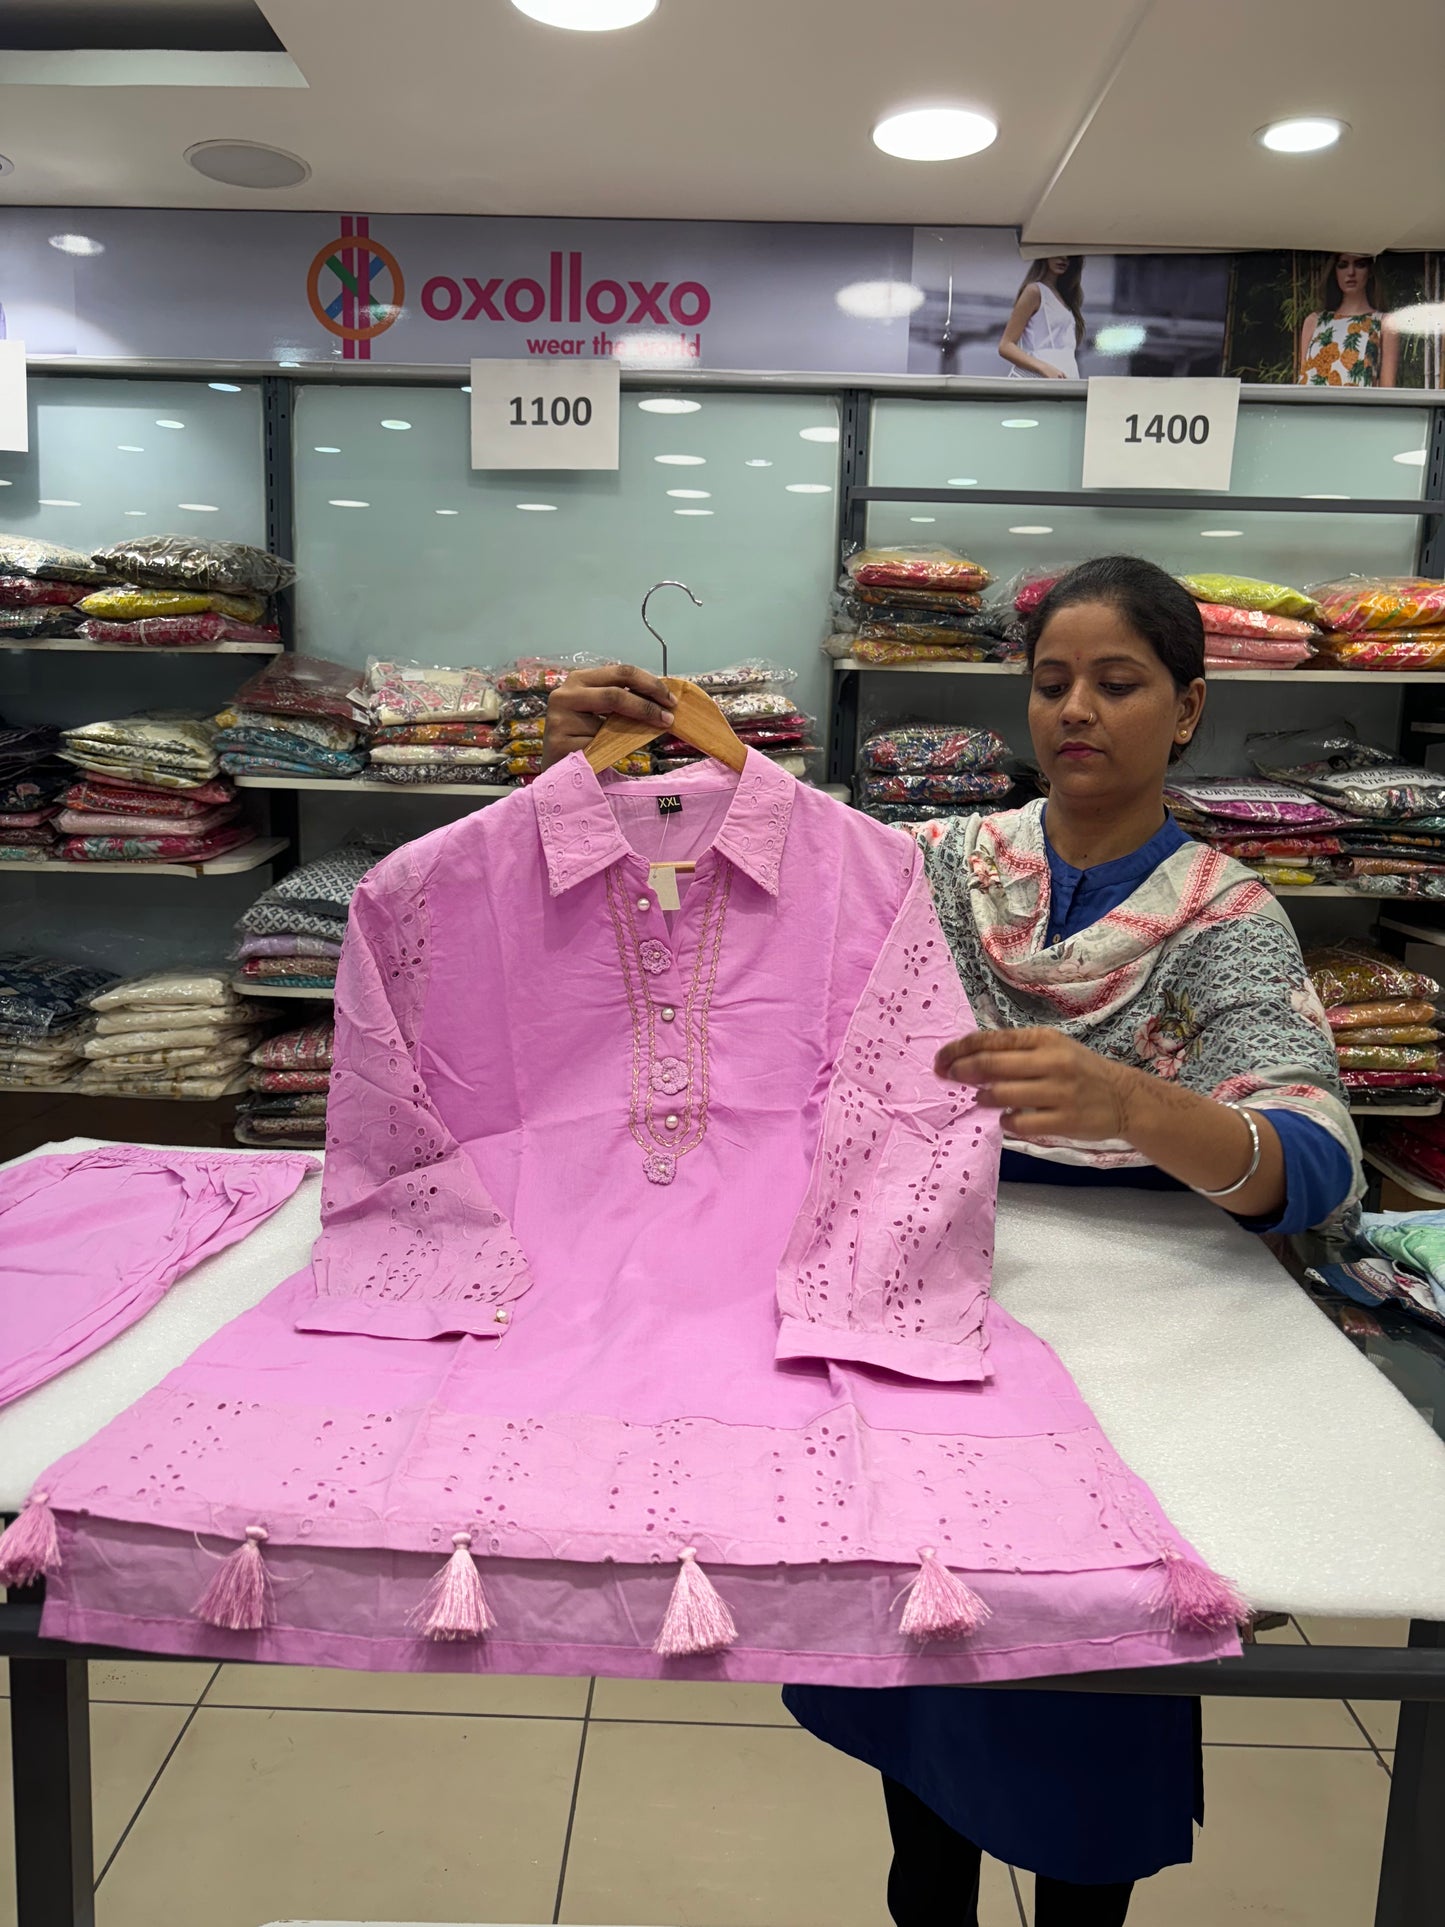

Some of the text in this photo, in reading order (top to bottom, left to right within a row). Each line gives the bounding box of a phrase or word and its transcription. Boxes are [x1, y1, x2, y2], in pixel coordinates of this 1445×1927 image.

[421, 251, 711, 327] oxolloxo
[526, 338, 586, 355] wear
[592, 331, 625, 355] the
[509, 396, 592, 427] 1100
[1124, 414, 1210, 444] 1400
[658, 797, 680, 808] XXL
